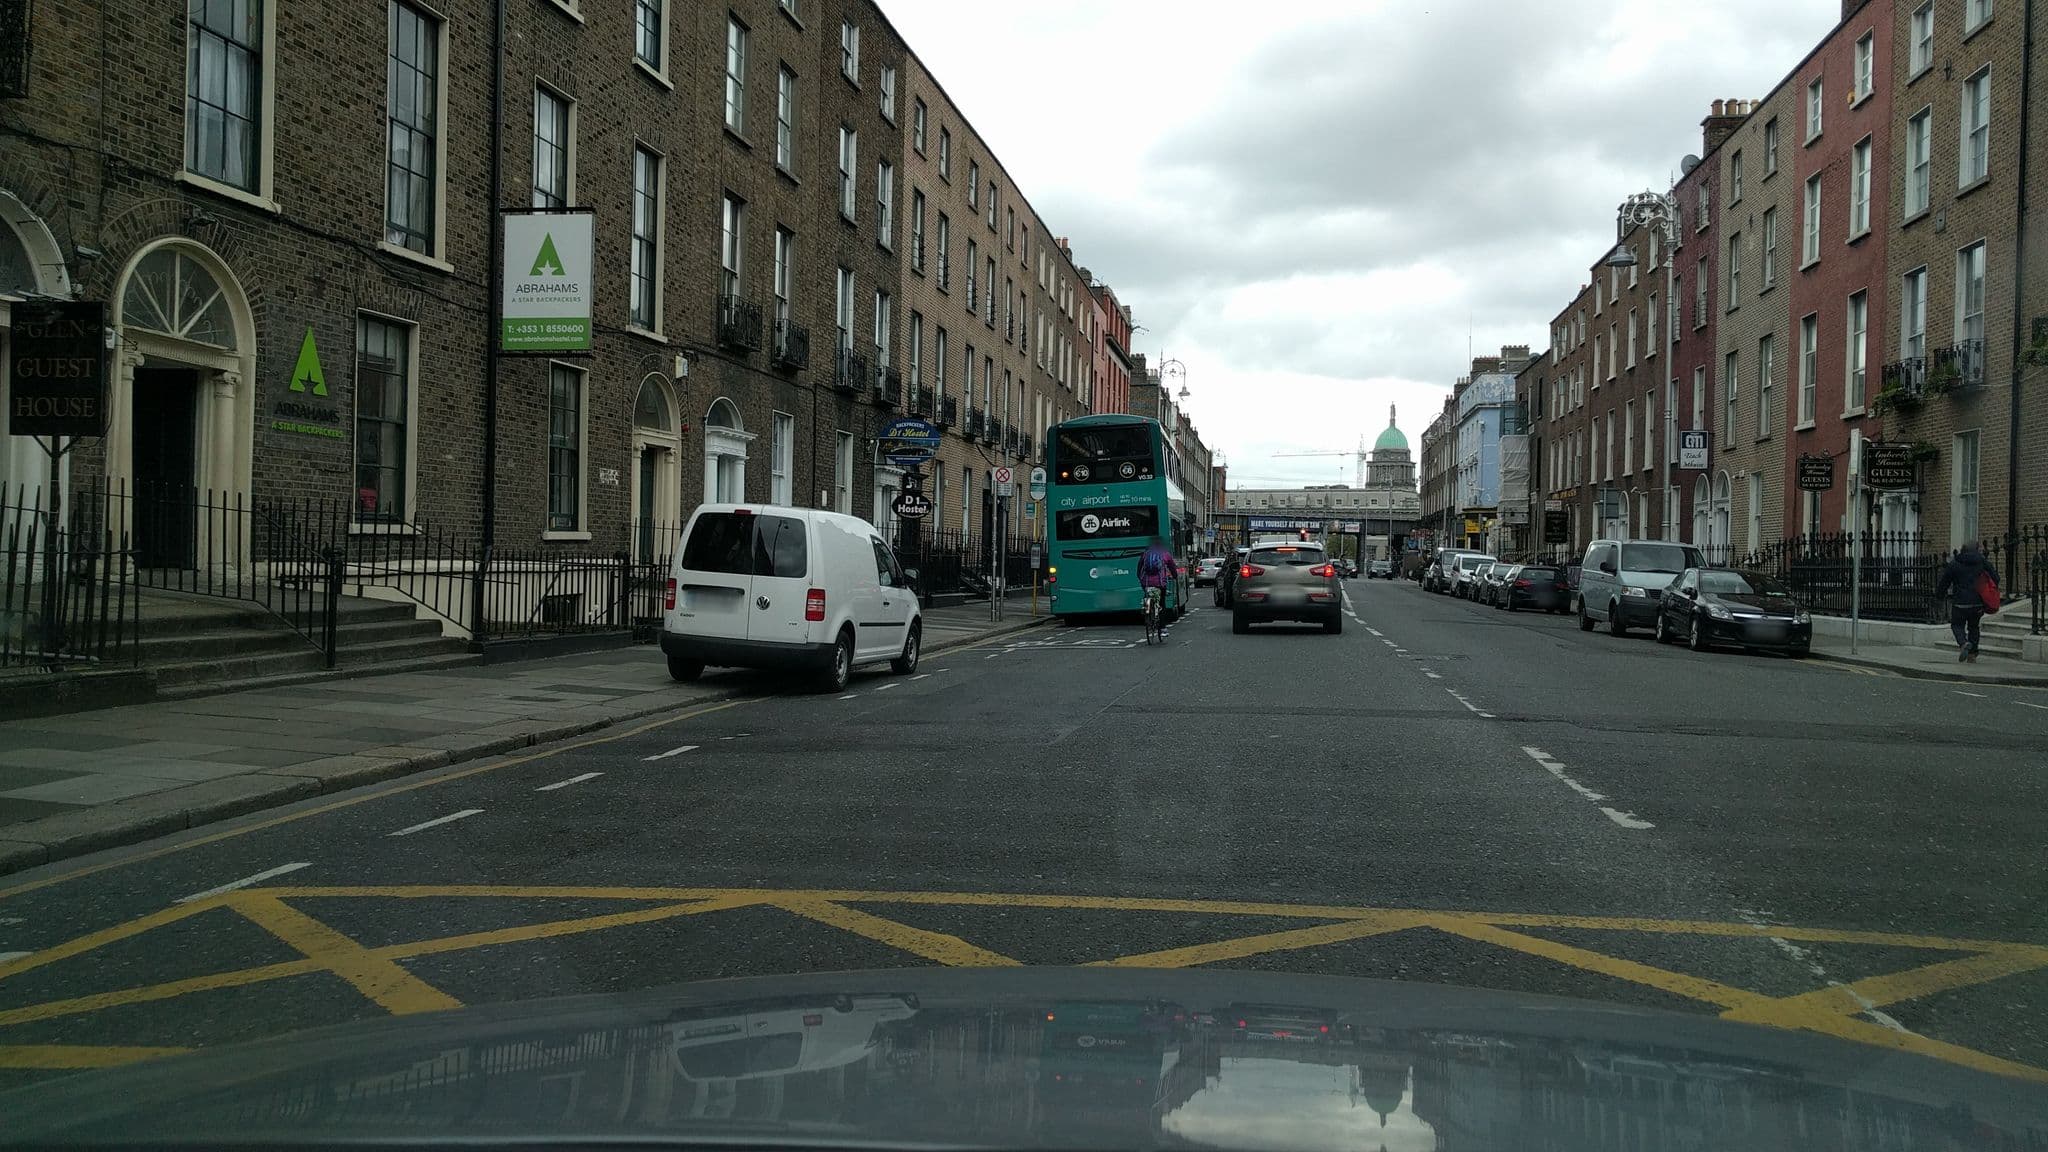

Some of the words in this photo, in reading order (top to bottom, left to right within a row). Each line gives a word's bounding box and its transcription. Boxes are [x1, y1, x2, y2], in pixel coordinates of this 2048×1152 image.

[516, 284, 579, 293] ABRAHAMS
[507, 325, 515, 334] T:
[516, 325, 538, 333] +353
[540, 325, 544, 333] 1
[546, 324, 584, 333] 8550600
[17, 358, 96, 378] GUEST
[16, 397, 96, 417] HOUSE
[274, 401, 340, 422] ABRAHAMS
[903, 429, 930, 437] Hostel
[1061, 498, 1076, 507] city
[1082, 496, 1110, 505] airport
[898, 504, 928, 513] Hostel
[1101, 517, 1130, 528] Airlink
[1251, 520, 1264, 528] MAKE
[1265, 520, 1288, 528] YOURSELF
